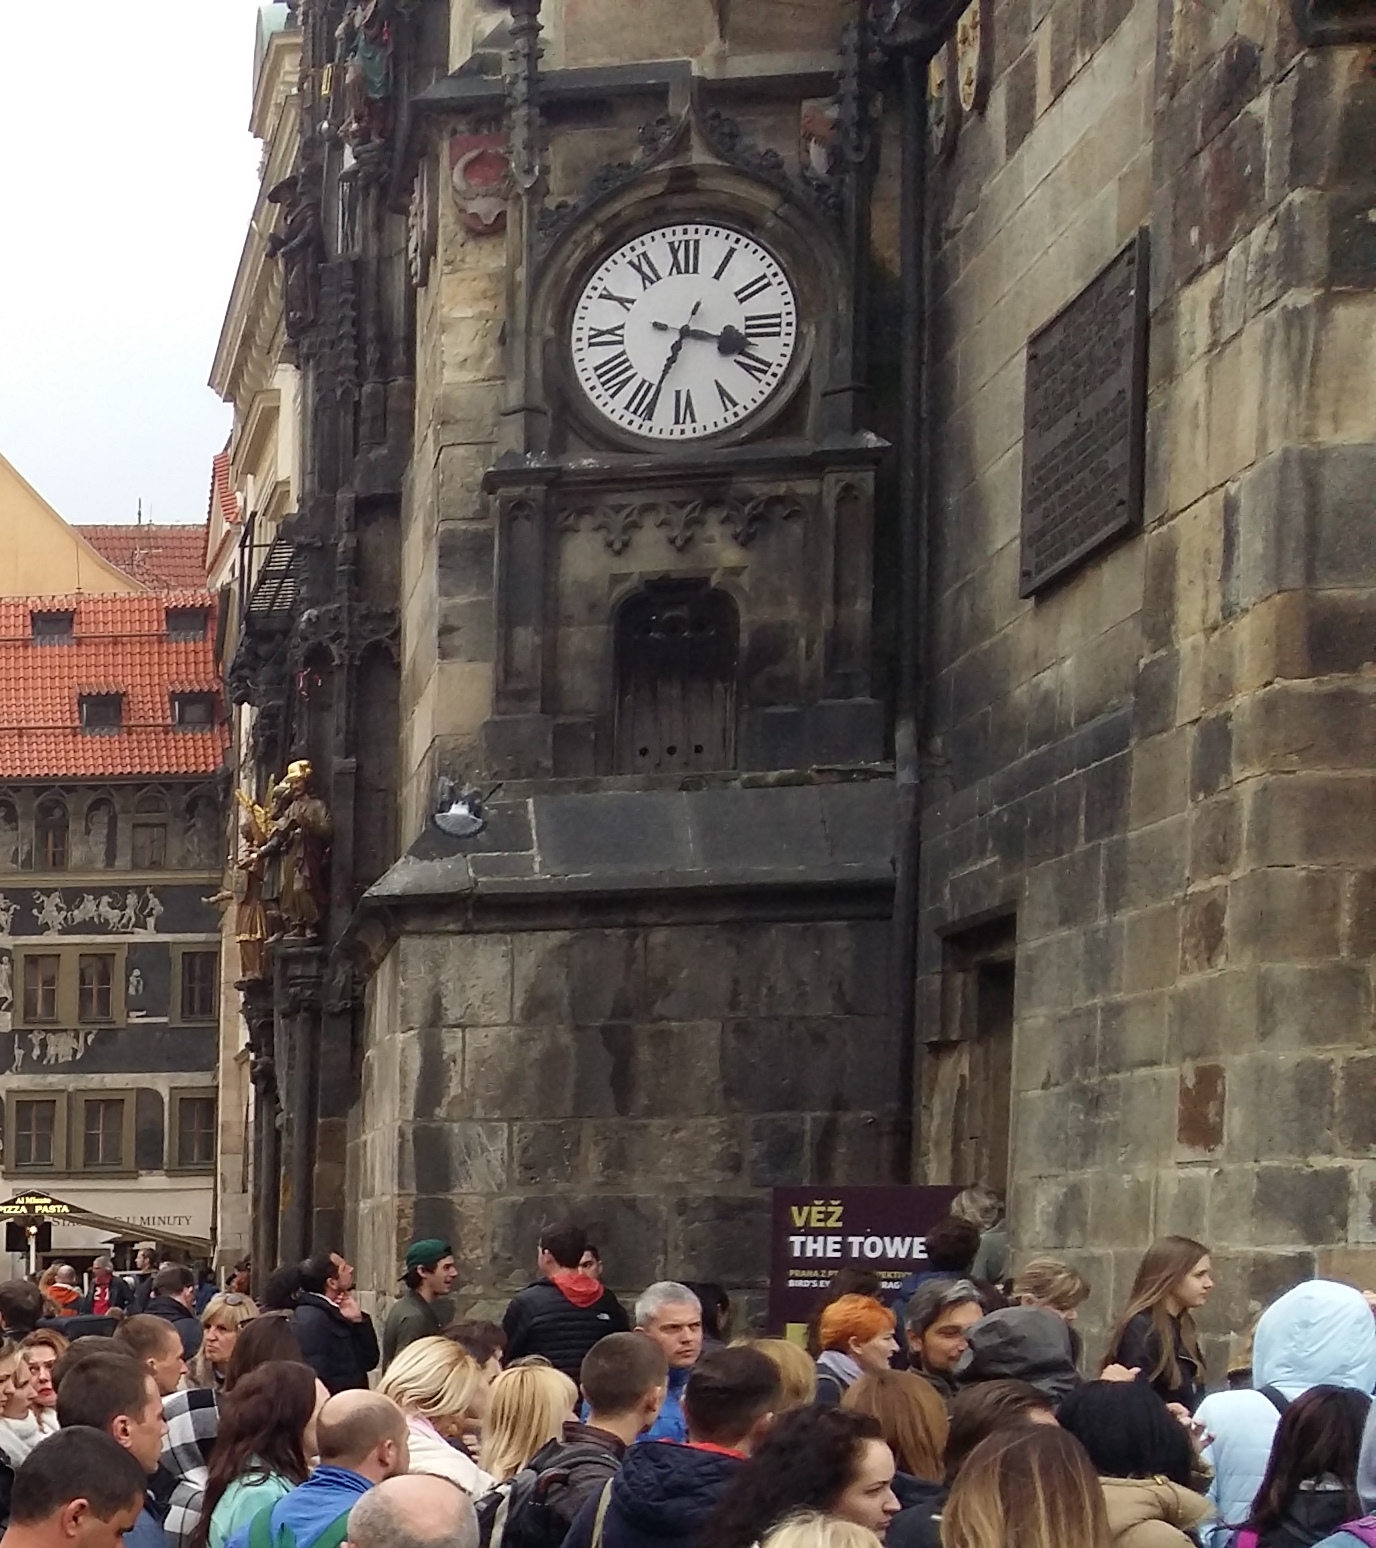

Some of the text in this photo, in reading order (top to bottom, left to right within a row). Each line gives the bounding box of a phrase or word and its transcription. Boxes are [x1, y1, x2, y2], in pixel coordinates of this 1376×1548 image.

[626, 250, 664, 292] XI
[667, 238, 701, 277] XII
[711, 245, 738, 281] I
[597, 286, 638, 313] X
[733, 272, 773, 305] II
[587, 321, 627, 349] IX
[744, 312, 783, 338] III
[592, 349, 639, 400] VIII
[733, 350, 774, 384] IV
[672, 388, 698, 426] VI
[713, 378, 740, 413] V
[34, 1204, 70, 1214] PASTA
[139, 1215, 192, 1226] MINUTY
[791, 1200, 844, 1228] VĚŽ
[789, 1235, 929, 1260] THE TOWE
[788, 1279, 903, 1290] BIRD'S EY RAG
